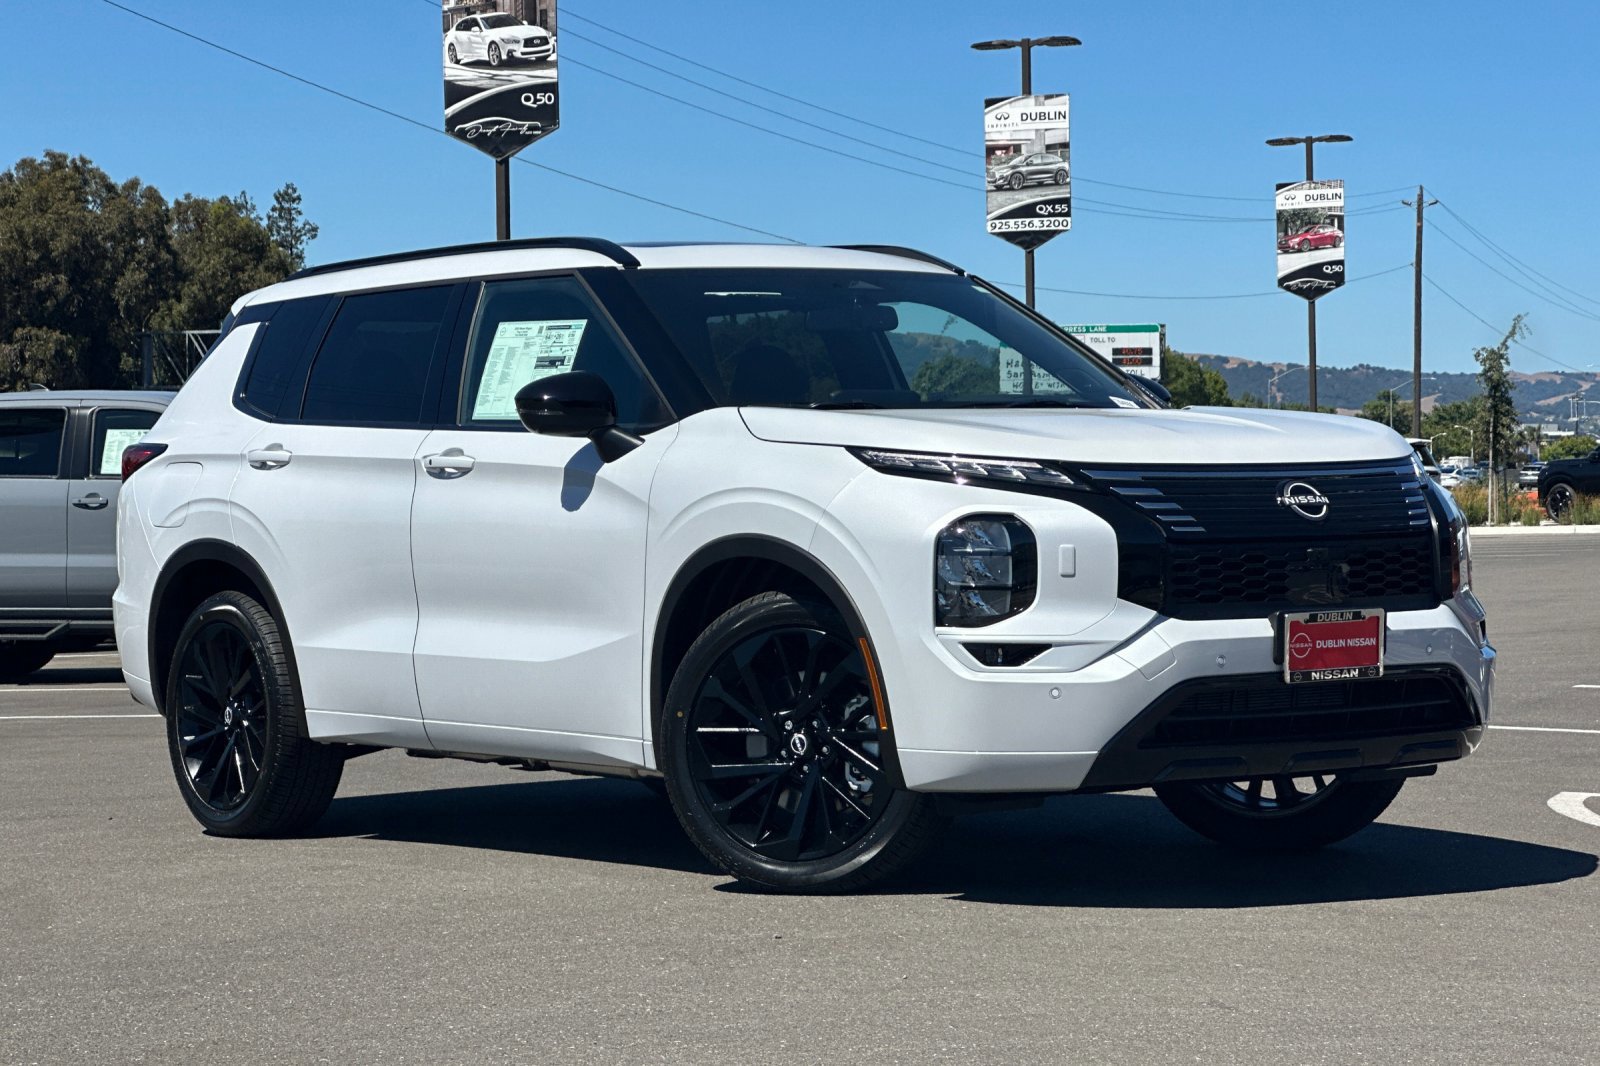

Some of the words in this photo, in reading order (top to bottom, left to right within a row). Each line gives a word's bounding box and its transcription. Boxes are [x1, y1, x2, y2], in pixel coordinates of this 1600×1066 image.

[1020, 111, 1066, 121] DUBLIN
[1304, 192, 1342, 202] DUBLIN
[990, 219, 1069, 231] 925.556.3200
[1284, 495, 1330, 505] NISSAN
[1317, 612, 1353, 622] DUBLIN
[1316, 639, 1346, 649] DUBLIN
[1347, 637, 1377, 647] NISSAN
[1311, 668, 1359, 681] NISSAN
